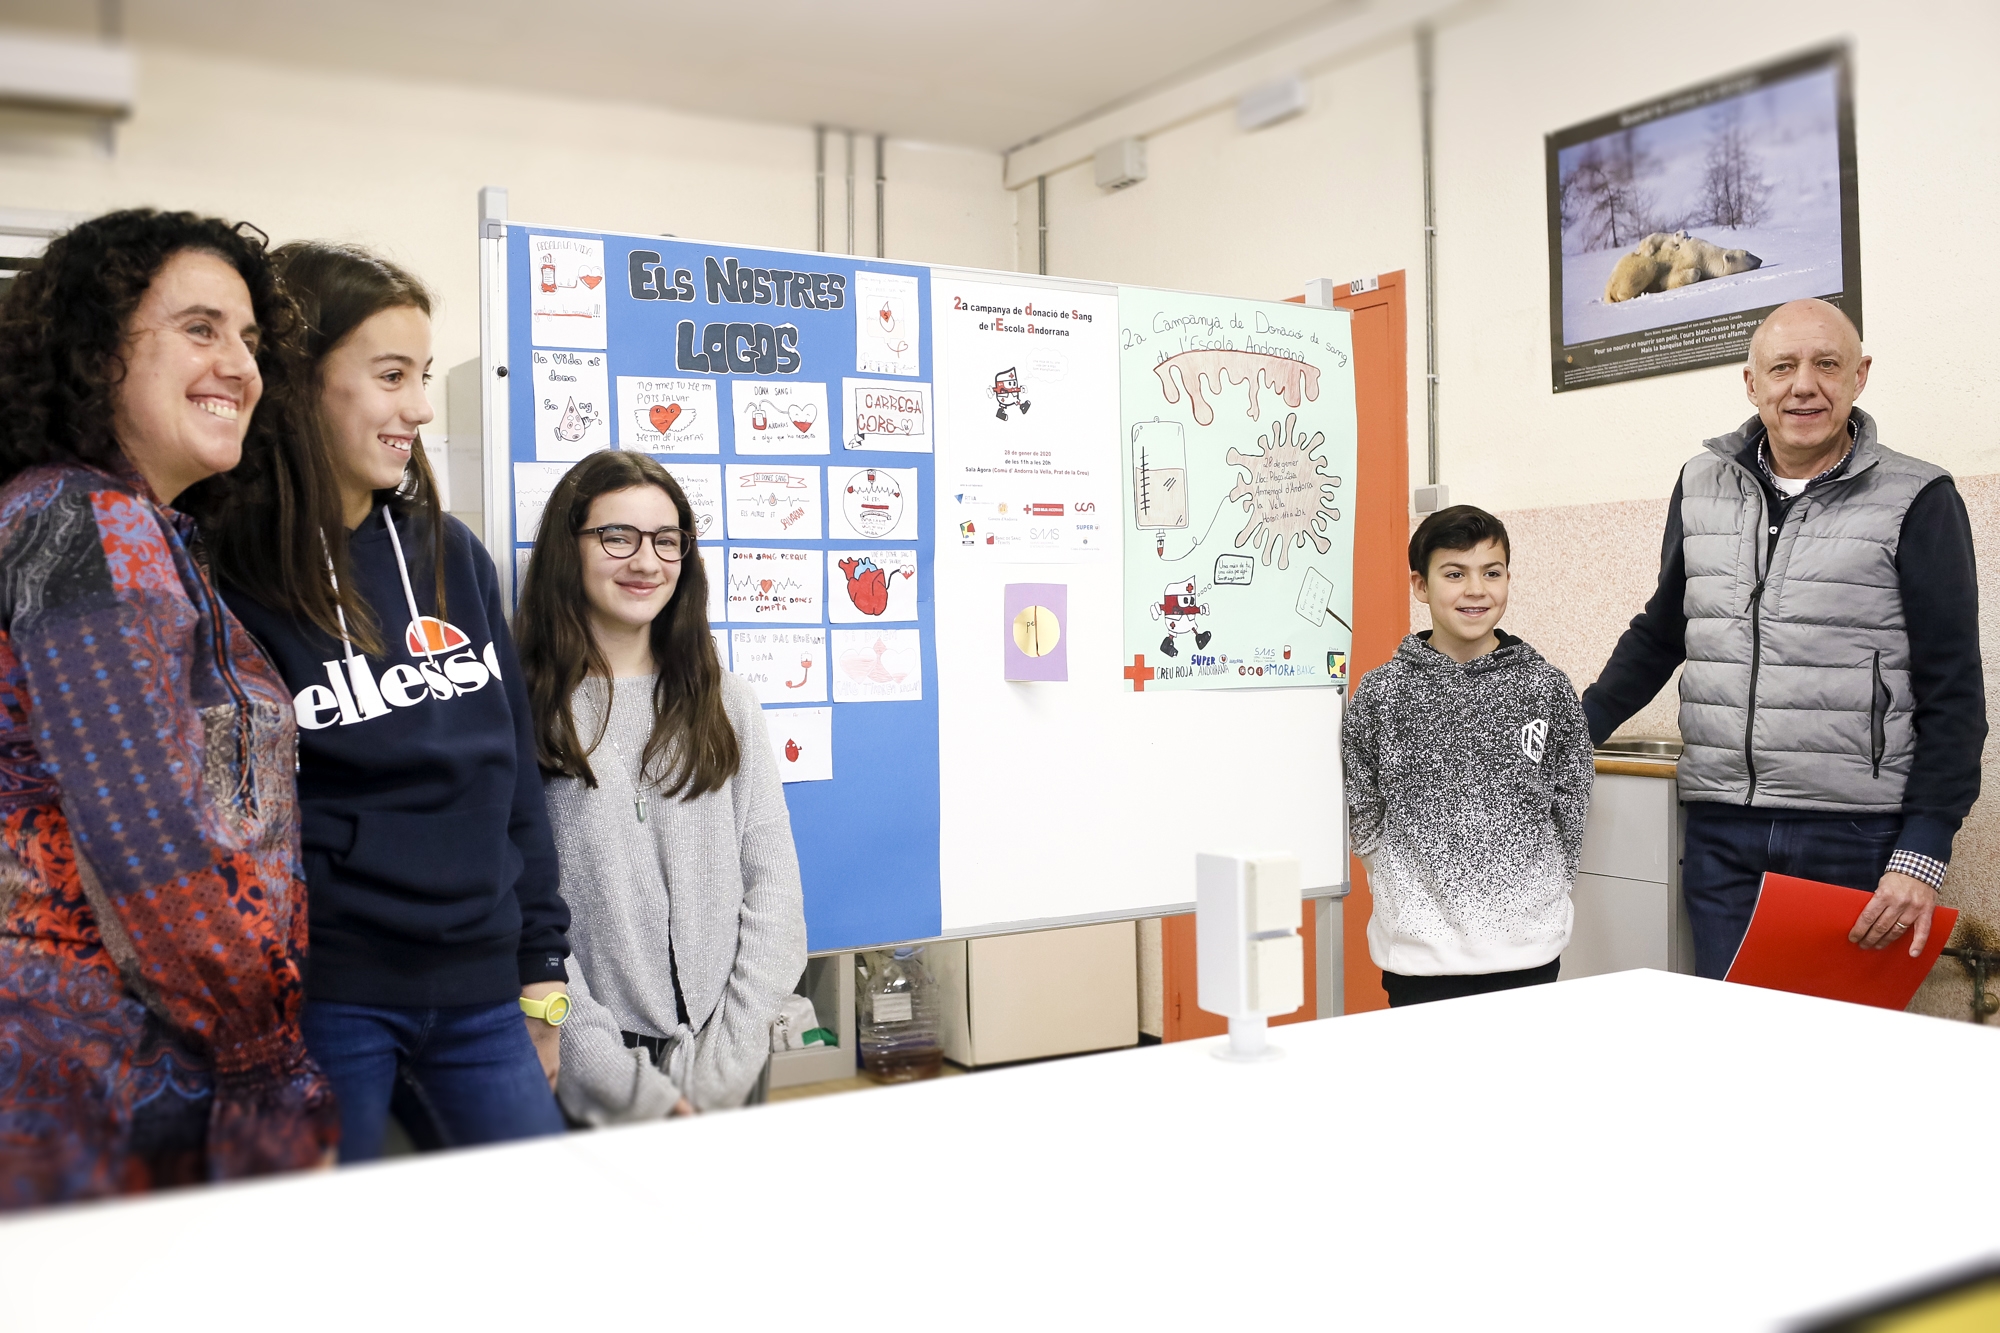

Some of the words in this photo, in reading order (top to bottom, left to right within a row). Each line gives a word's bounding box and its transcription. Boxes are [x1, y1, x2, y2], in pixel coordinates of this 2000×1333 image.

[704, 256, 846, 311] NOSTRES
[1351, 279, 1364, 293] 001
[954, 296, 968, 311] 2a
[970, 303, 1011, 316] campanya
[1013, 307, 1022, 315] de
[1025, 303, 1058, 318] donació
[1060, 310, 1069, 319] de
[1072, 310, 1092, 323] Sang
[979, 322, 989, 330] de
[990, 317, 1025, 333] l'Escola
[1027, 324, 1069, 337] andorrana
[1122, 328, 1146, 350] 2a
[1153, 312, 1223, 336] Campanya
[1230, 312, 1244, 329] de
[1256, 311, 1303, 339] Donació
[1310, 332, 1319, 344] de
[1325, 342, 1347, 368] sang
[1613, 343, 1630, 352] nourrir
[1637, 338, 1655, 347] nourrir
[1666, 334, 1679, 343] petit,
[1680, 331, 1694, 339] l'ours
[1696, 328, 1710, 336] blanc
[1737, 320, 1757, 329] phoque
[1641, 346, 1653, 354] Mais
[1660, 341, 1682, 351] banquise
[1702, 335, 1717, 343] l'ours
[1728, 329, 1748, 338] affamé.
[675, 319, 801, 375] LOGOS
[1157, 350, 1173, 364] de
[1246, 335, 1306, 363] Andorrana
[553, 353, 582, 365] Vida
[549, 369, 577, 382] dona
[865, 394, 922, 414] CARREGA
[750, 591, 769, 602] GOTA
[756, 603, 787, 613] COMPTA
[734, 632, 751, 643] FES
[1191, 654, 1216, 666] SUPER
[1157, 666, 1174, 680] CREU
[1176, 666, 1193, 678] ROJA
[1269, 664, 1295, 676] MORA
[1297, 665, 1316, 675] BANC
